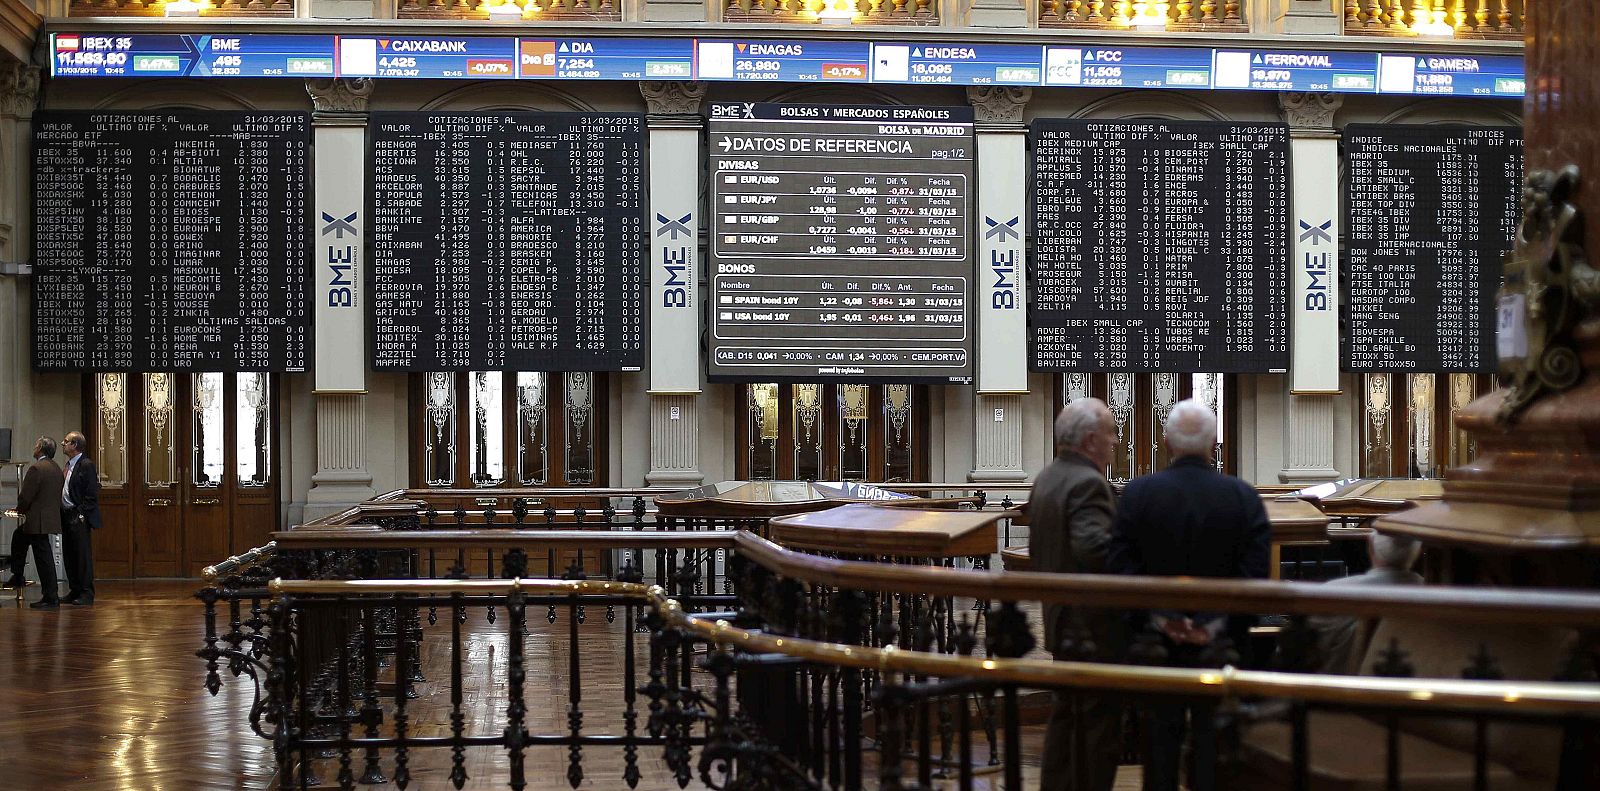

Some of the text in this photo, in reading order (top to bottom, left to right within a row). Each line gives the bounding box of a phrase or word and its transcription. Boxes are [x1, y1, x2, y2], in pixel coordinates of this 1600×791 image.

[82, 37, 131, 50] IBEX 35
[212, 39, 241, 50] BME
[392, 40, 467, 52] CAIXABANK
[571, 42, 594, 53] DIA
[749, 45, 803, 56] ENAGAS
[924, 48, 976, 59] ENDESA
[1096, 50, 1122, 62] FCC
[1264, 54, 1332, 67] FERROVIAL
[379, 57, 416, 68] 4,425
[558, 59, 594, 70] 7,254
[736, 61, 780, 72] 26,980
[1429, 58, 1479, 71] GAMESA
[471, 63, 508, 73] -0,07%
[911, 64, 952, 75] 18,095
[1084, 66, 1121, 77] 11,505
[780, 107, 819, 117] BOLSAS
[822, 108, 830, 117] Y
[833, 108, 889, 118] MERCADOS
[893, 109, 950, 119] ESPAÑOLES
[90, 115, 162, 123] COTIZACIONES
[428, 116, 499, 124] COTIZACIONES
[879, 125, 910, 134] BOLSA
[923, 126, 964, 135] MADRID
[1087, 124, 1285, 134] COTIZACIONES 31/03/2015
[37, 131, 102, 139] MERCADO ETF
[375, 141, 417, 149] ABENGOA
[733, 137, 964, 159] DATOS DE REFERENCIA pag.1/2
[1404, 145, 1457, 153] NACIONALES
[1037, 148, 1082, 156] ACERINOX
[434, 158, 470, 166] 72.550
[719, 161, 759, 170] DIVISAS
[375, 174, 417, 182] AMADEUS
[740, 175, 779, 184] EUR/USD
[886, 177, 898, 185] Dif.
[901, 177, 908, 185] %
[928, 177, 950, 186] Fecha
[173, 183, 221, 191] CARBURES
[919, 188, 957, 197] 31/03/15
[740, 195, 950, 206] EUR/JPY Fecha
[919, 208, 957, 217] 31/03/15
[173, 216, 221, 224] EUROESPE
[740, 215, 950, 225] EUR/GBP Fecha
[919, 228, 957, 236] 31/03/15
[740, 235, 950, 245] EUR/CHF Fecha
[173, 250, 221, 258] IMAGINAR
[919, 248, 957, 256] 31/03/15
[173, 267, 221, 275] MASMOVIL
[718, 264, 755, 273] BONOS
[328, 246, 351, 307] BME
[663, 247, 685, 308] BME
[1037, 270, 1082, 278] PROSEGUR
[992, 250, 1014, 309] BME
[1306, 252, 1326, 311] BME
[721, 281, 750, 289] Nombre
[872, 283, 891, 291] Dif.%
[898, 283, 912, 291] Ant.
[932, 283, 954, 291] Fecha
[735, 296, 760, 305] SPAIN
[762, 296, 781, 305] bond
[783, 296, 799, 305] 10Y
[819, 297, 837, 306] 1,22
[898, 298, 916, 307] 1,30
[925, 298, 963, 307] 31/03/15
[1037, 294, 1077, 302] ZARDOYA
[375, 308, 470, 316] GRIFOLS 40.430
[197, 317, 287, 325] ULTIMAS SALIDAS
[735, 313, 751, 321] USA
[753, 313, 772, 321] bond
[774, 313, 790, 321] 10Y
[819, 314, 837, 322] 1,95
[842, 314, 863, 322] -0,01
[898, 314, 916, 323] 1,96
[925, 314, 963, 323] 31/03/15
[1165, 320, 1210, 328] TECNOCOM
[173, 326, 221, 334] EUROCONS
[376, 334, 470, 342] INDITEX 30.160
[511, 334, 558, 342] USIMINAS
[376, 350, 470, 358] JAZZTEL 12.710
[738, 352, 753, 360] D15
[757, 352, 778, 361] 0,041
[789, 352, 812, 361] 0,00%
[825, 352, 844, 361] CAM
[849, 352, 864, 362] 1,34
[876, 352, 898, 362] 0,00%
[38, 359, 67, 367] JAPAN
[1037, 360, 1077, 368] BAVIERA
